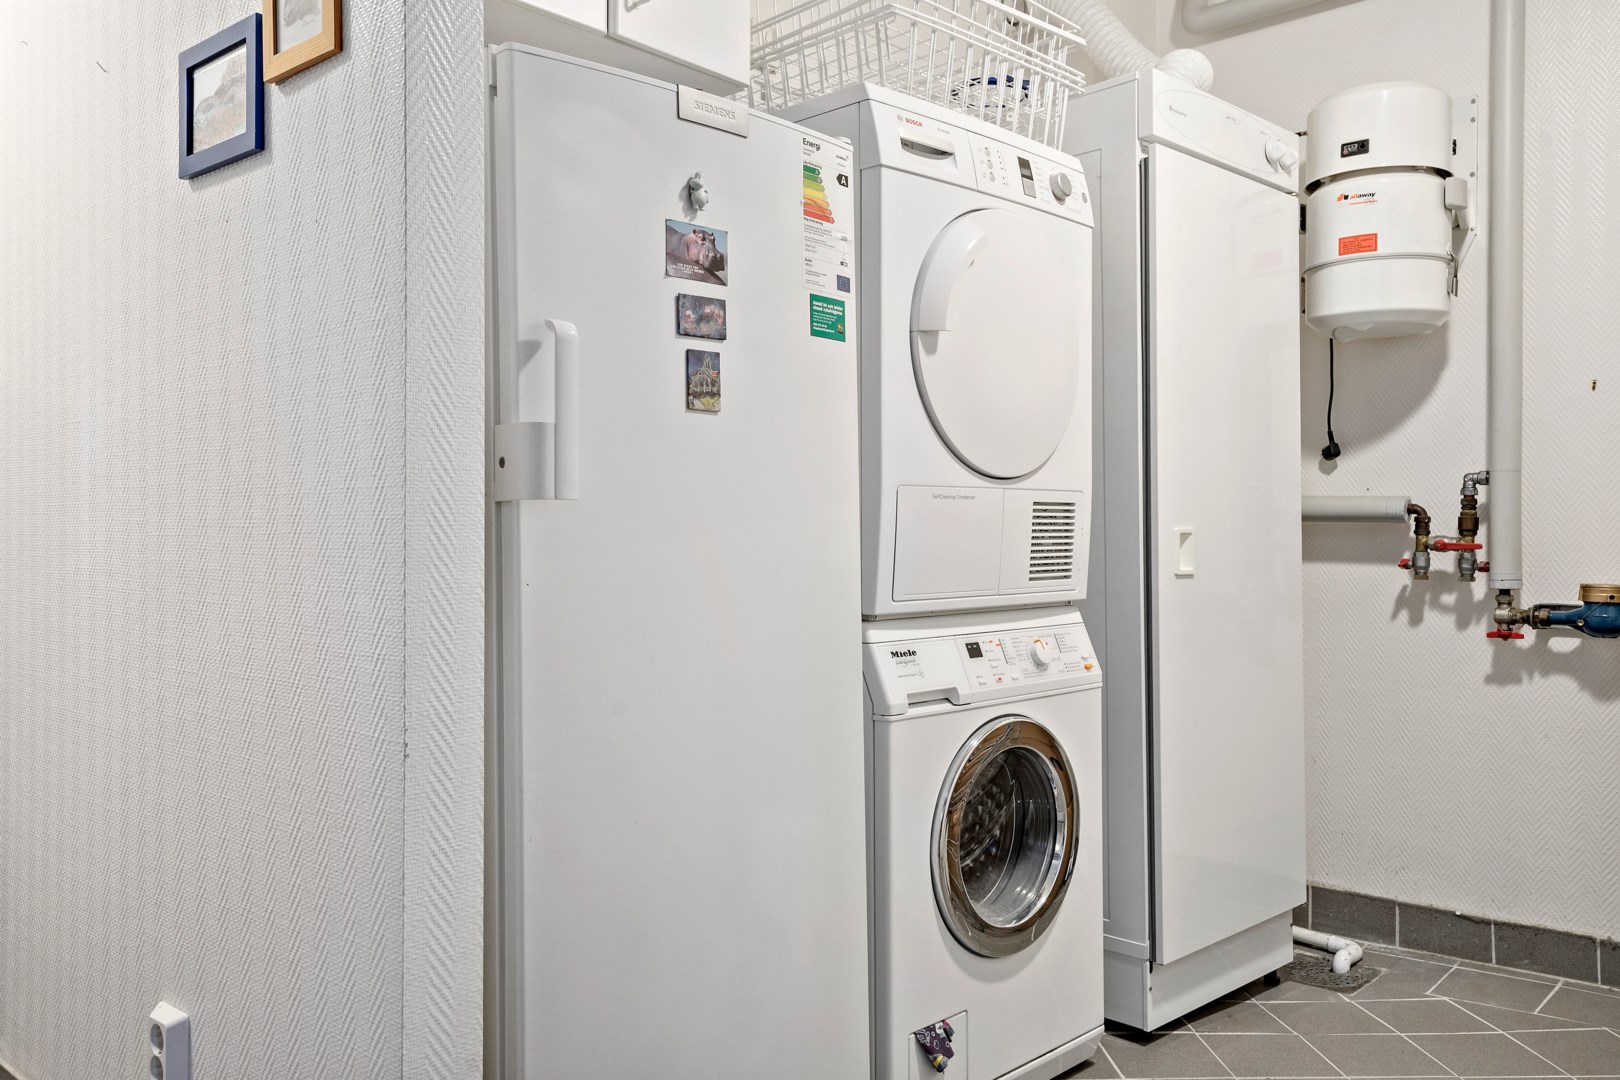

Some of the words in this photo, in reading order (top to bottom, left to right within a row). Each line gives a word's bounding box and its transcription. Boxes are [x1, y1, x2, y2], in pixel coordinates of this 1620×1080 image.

[693, 100, 736, 120] SIEMENS
[1349, 192, 1376, 200] allaway
[890, 649, 917, 659] Miele
